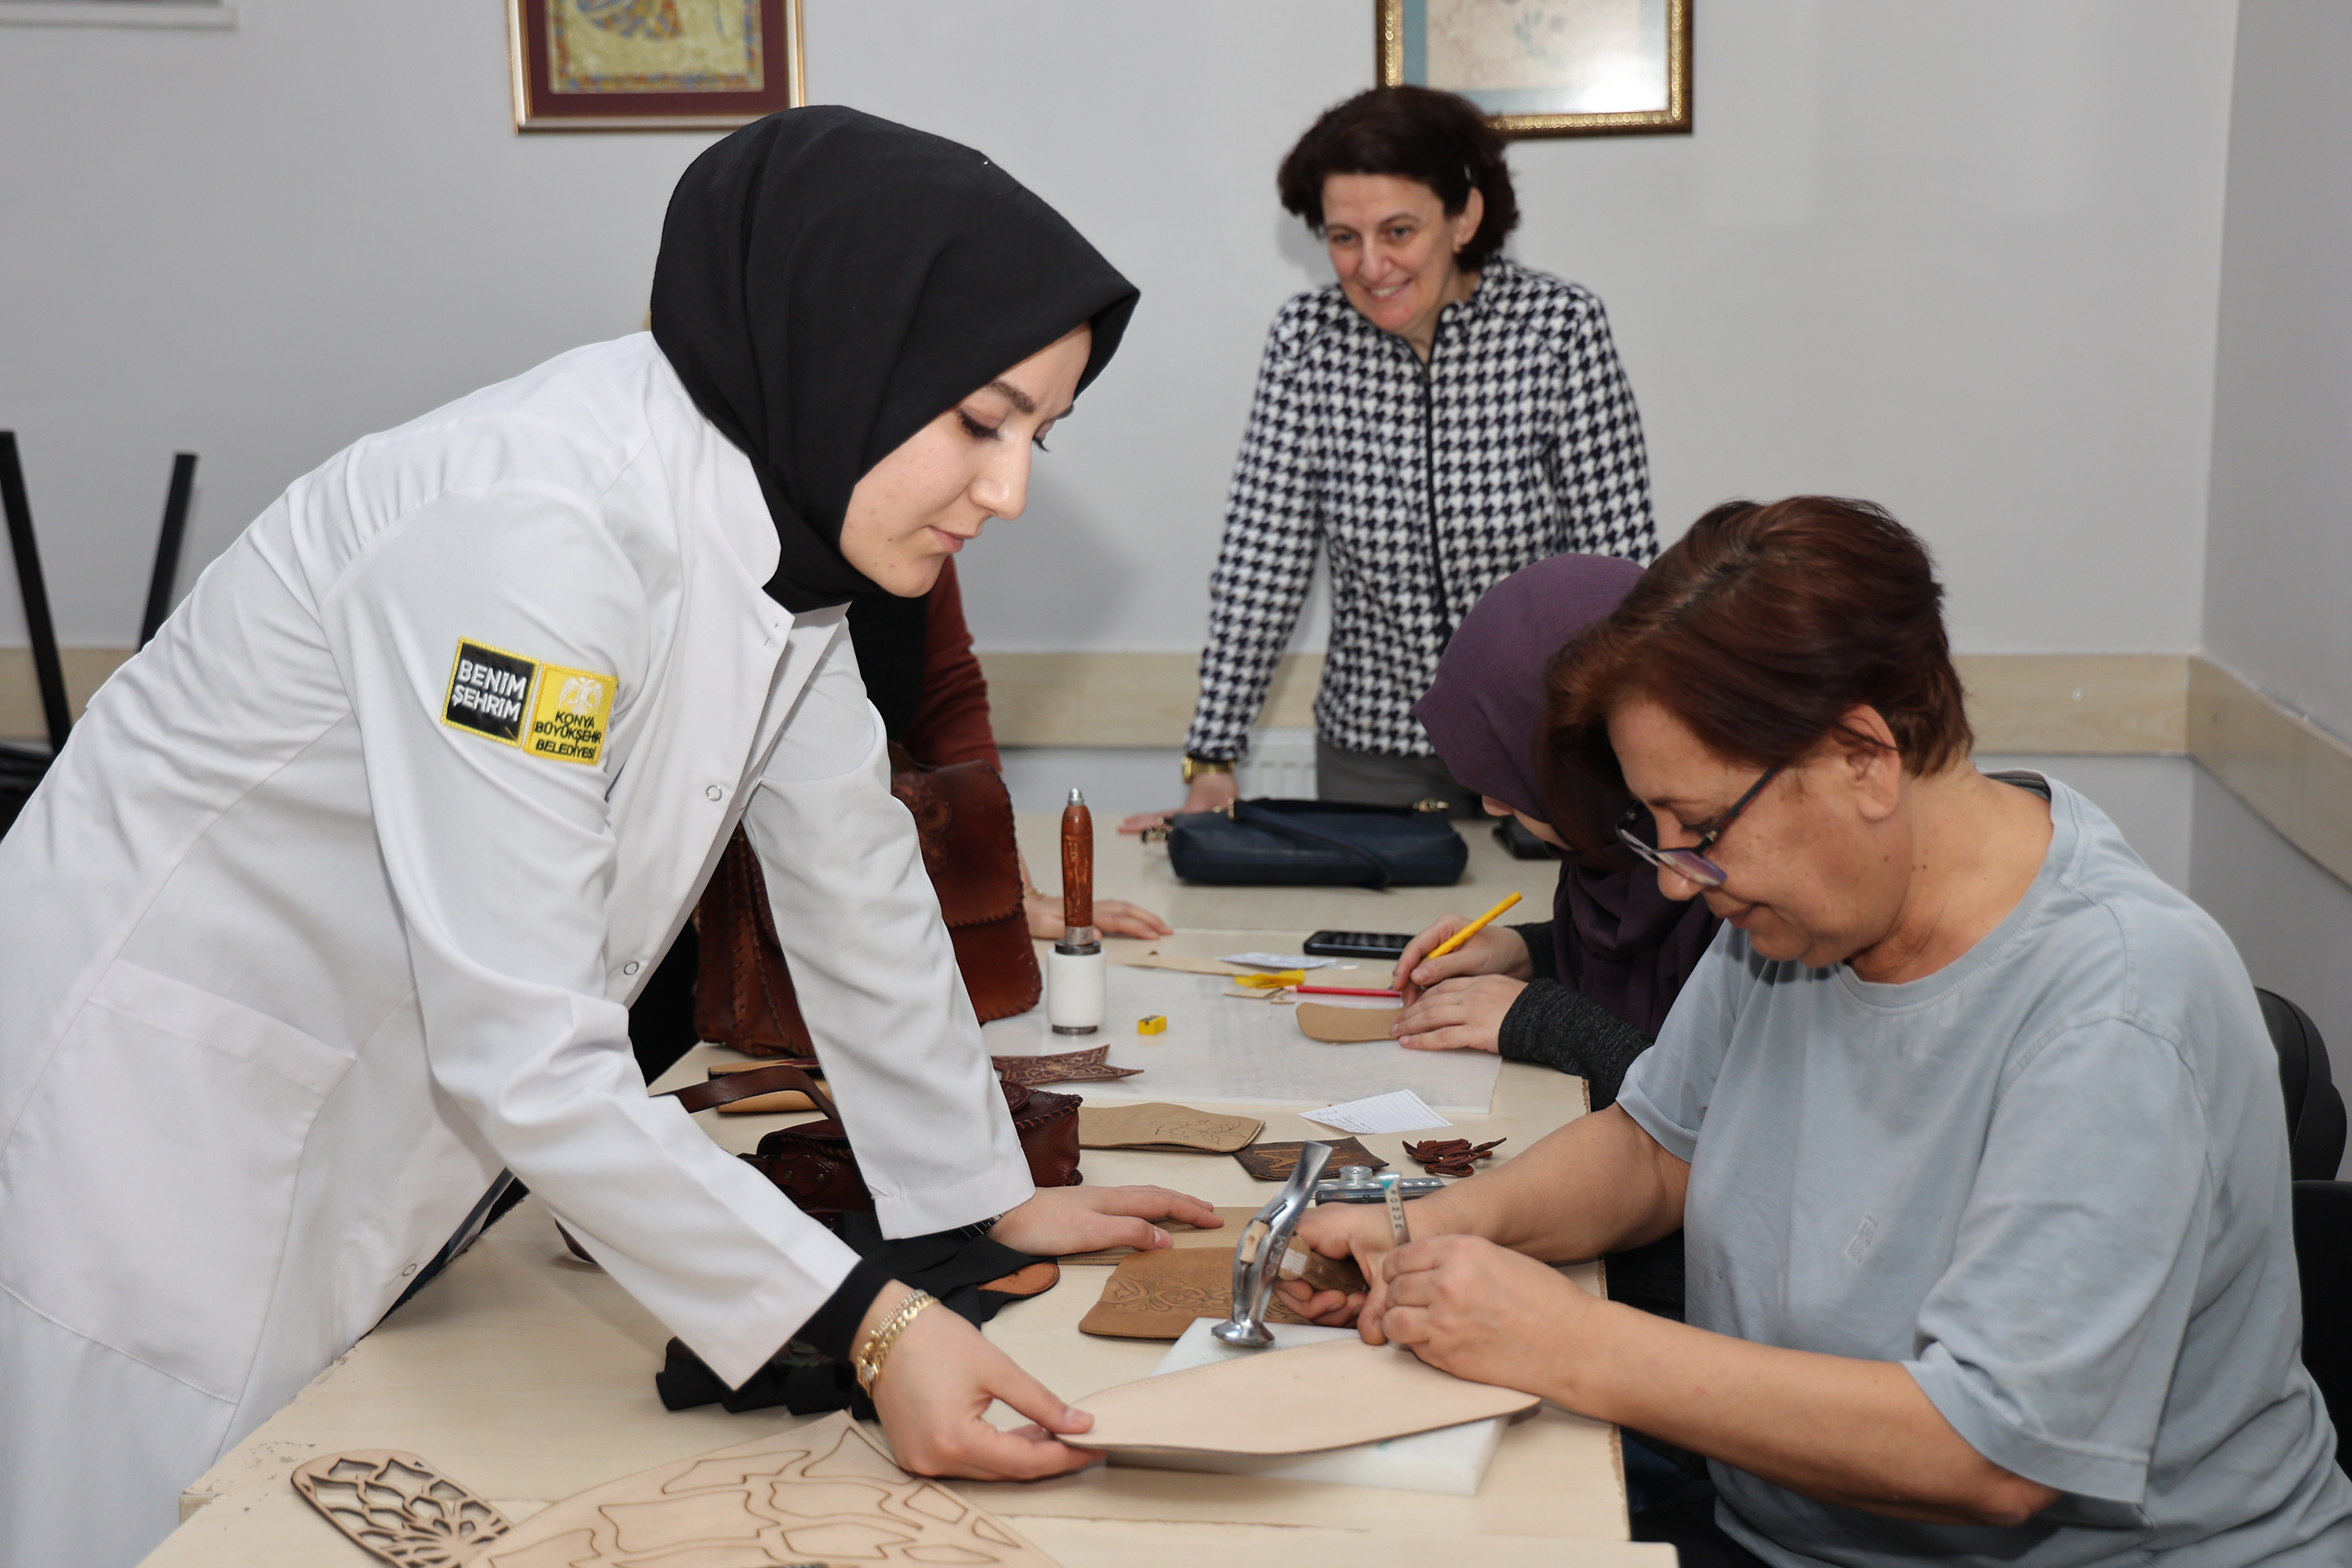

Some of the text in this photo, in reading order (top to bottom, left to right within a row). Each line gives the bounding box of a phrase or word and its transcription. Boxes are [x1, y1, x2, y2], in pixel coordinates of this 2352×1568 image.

[458, 660, 527, 699] BENİM
[452, 684, 521, 722] ŞEHRİM
[535, 721, 601, 744] BÜYÜKŞEHİR
[555, 711, 595, 729] KONYA
